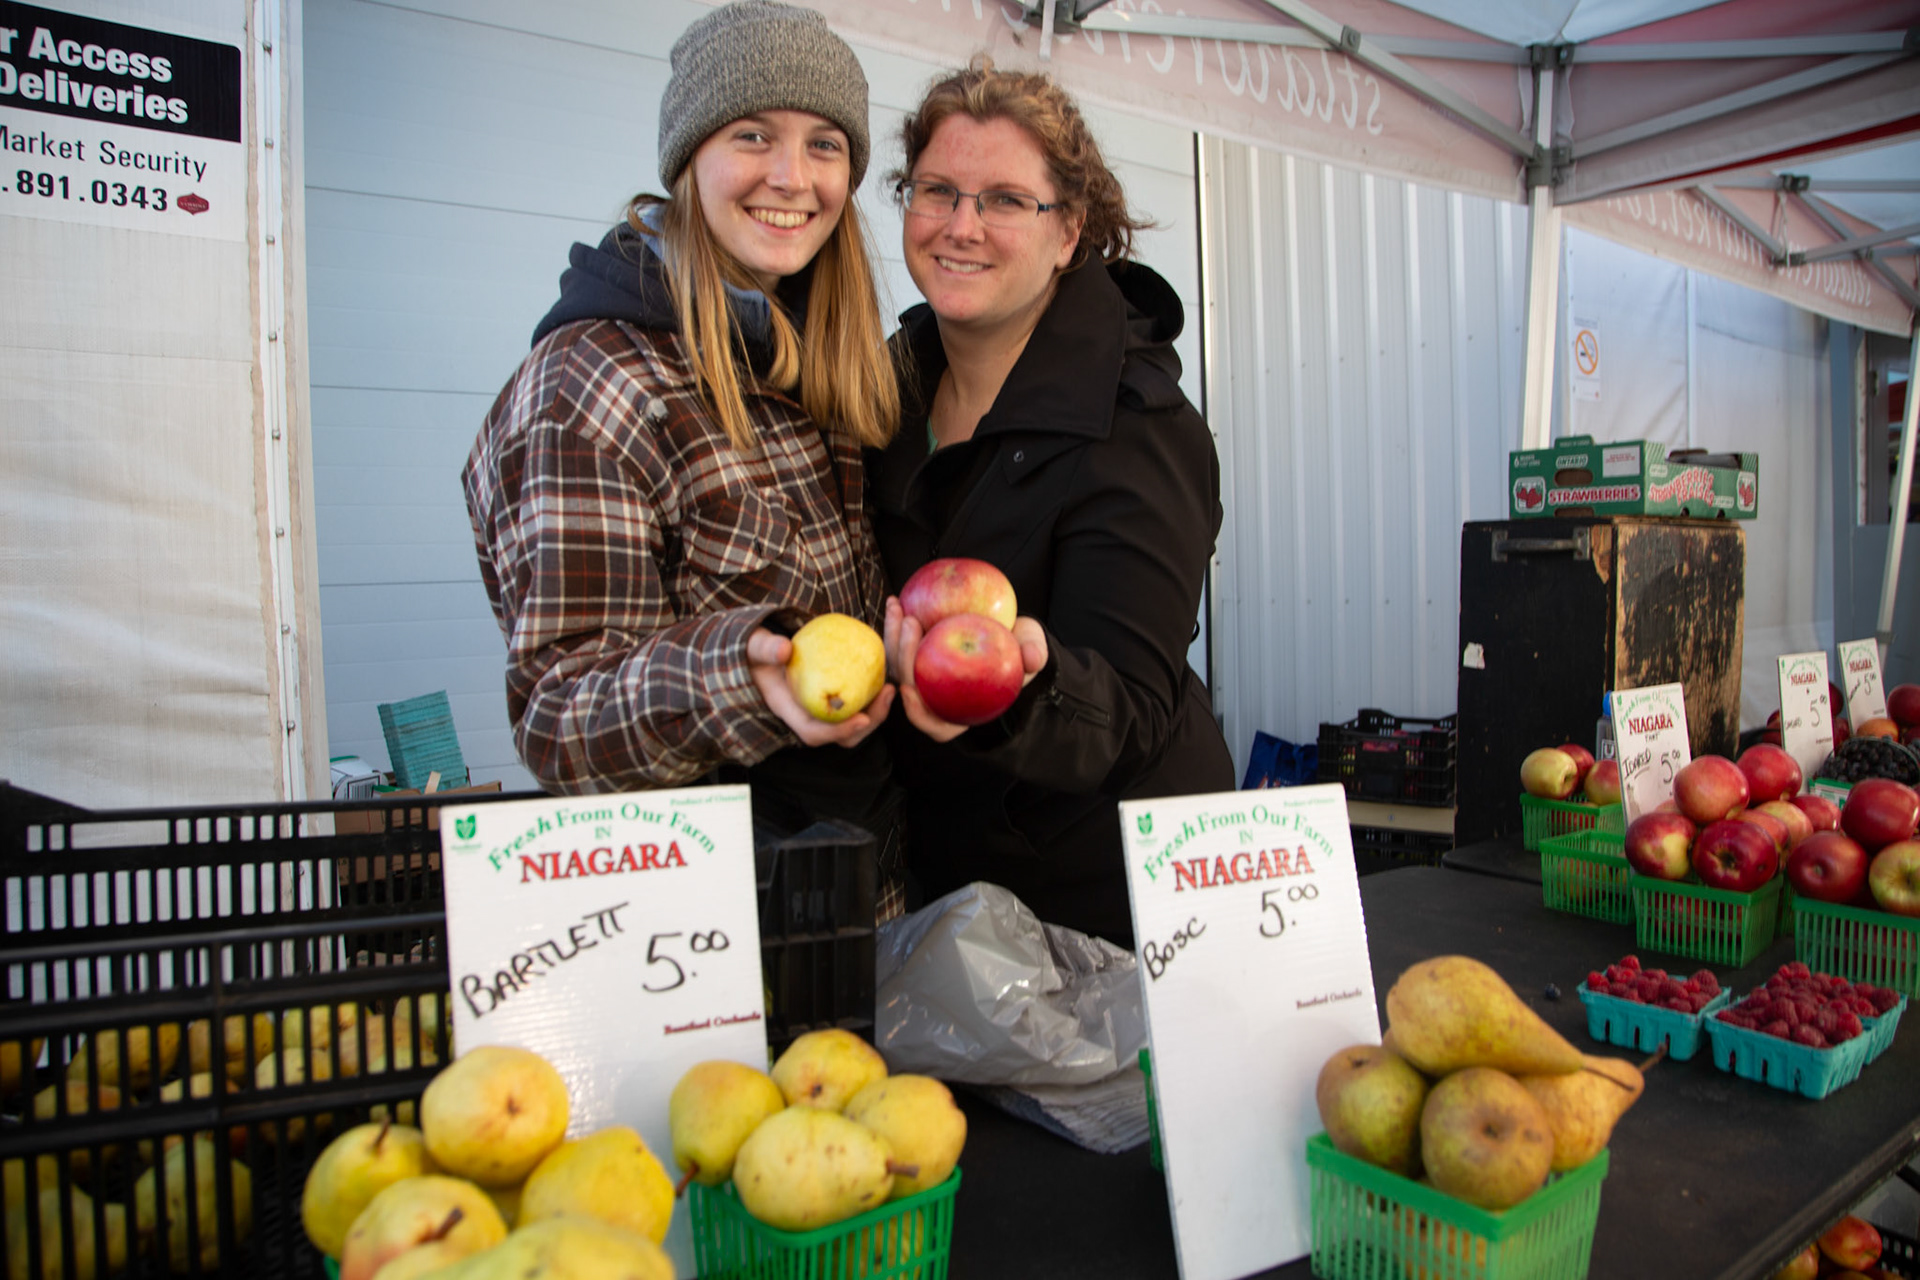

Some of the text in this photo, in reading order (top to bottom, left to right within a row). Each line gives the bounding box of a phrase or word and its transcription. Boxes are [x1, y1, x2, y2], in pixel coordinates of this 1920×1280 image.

[28, 26, 173, 83] Access
[0, 60, 189, 124] Deliveries
[99, 140, 208, 183] Security
[1549, 486, 1641, 505] STRAWBERRIES
[1649, 466, 1715, 503] STRAWBERRIES
[1790, 671, 1817, 687] NIAGARA
[1628, 713, 1674, 736] NIAGARA
[488, 802, 716, 872] Fresh From Our Farm
[595, 826, 612, 840] IN
[1143, 804, 1335, 882] Fresh From Our Farm
[1239, 829, 1254, 845] IN
[519, 840, 688, 884] NIAGARA
[1171, 844, 1316, 893] NIAGARA
[460, 901, 630, 1019] BARTLETT
